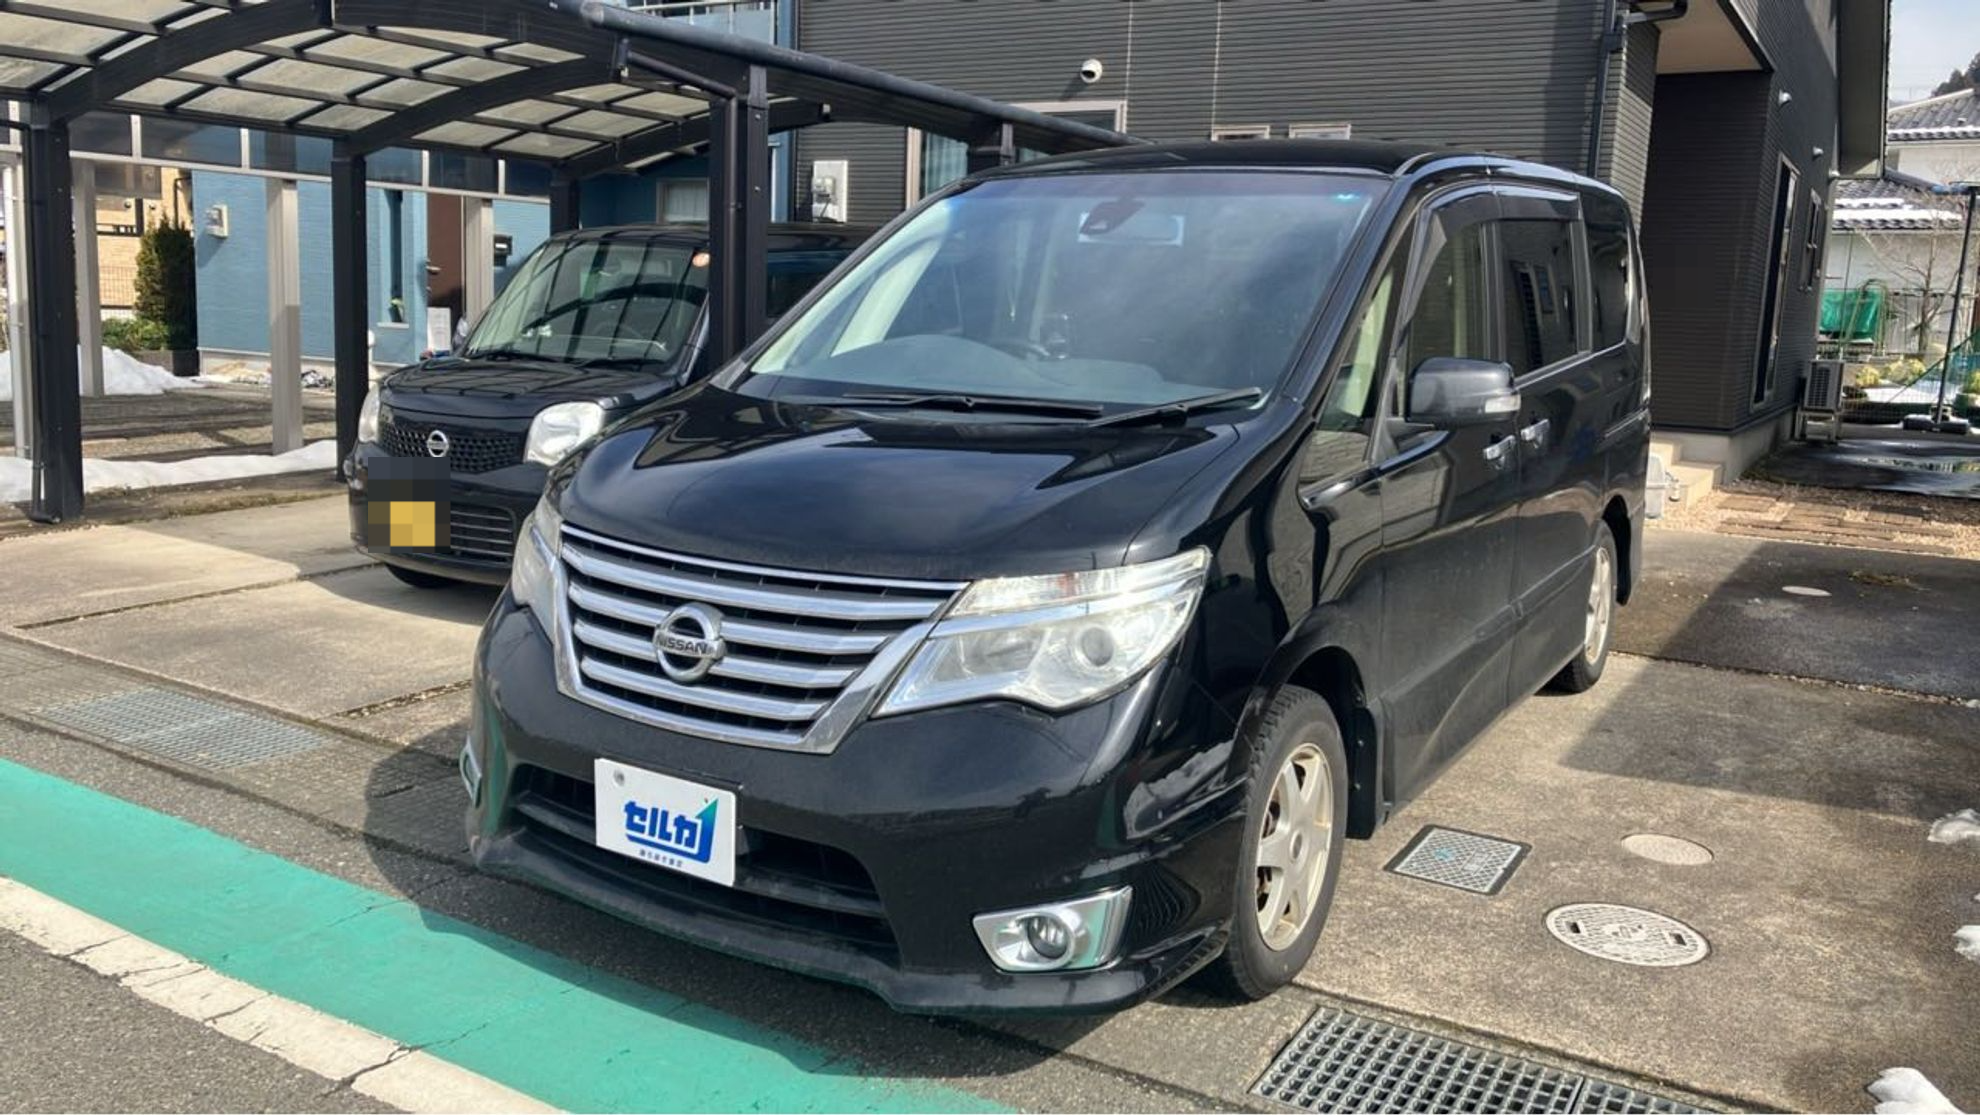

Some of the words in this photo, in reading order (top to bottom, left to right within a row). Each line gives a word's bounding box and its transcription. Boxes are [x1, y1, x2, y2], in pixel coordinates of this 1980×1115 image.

[656, 633, 709, 655] NISSAN
[624, 801, 698, 849] セルカ
